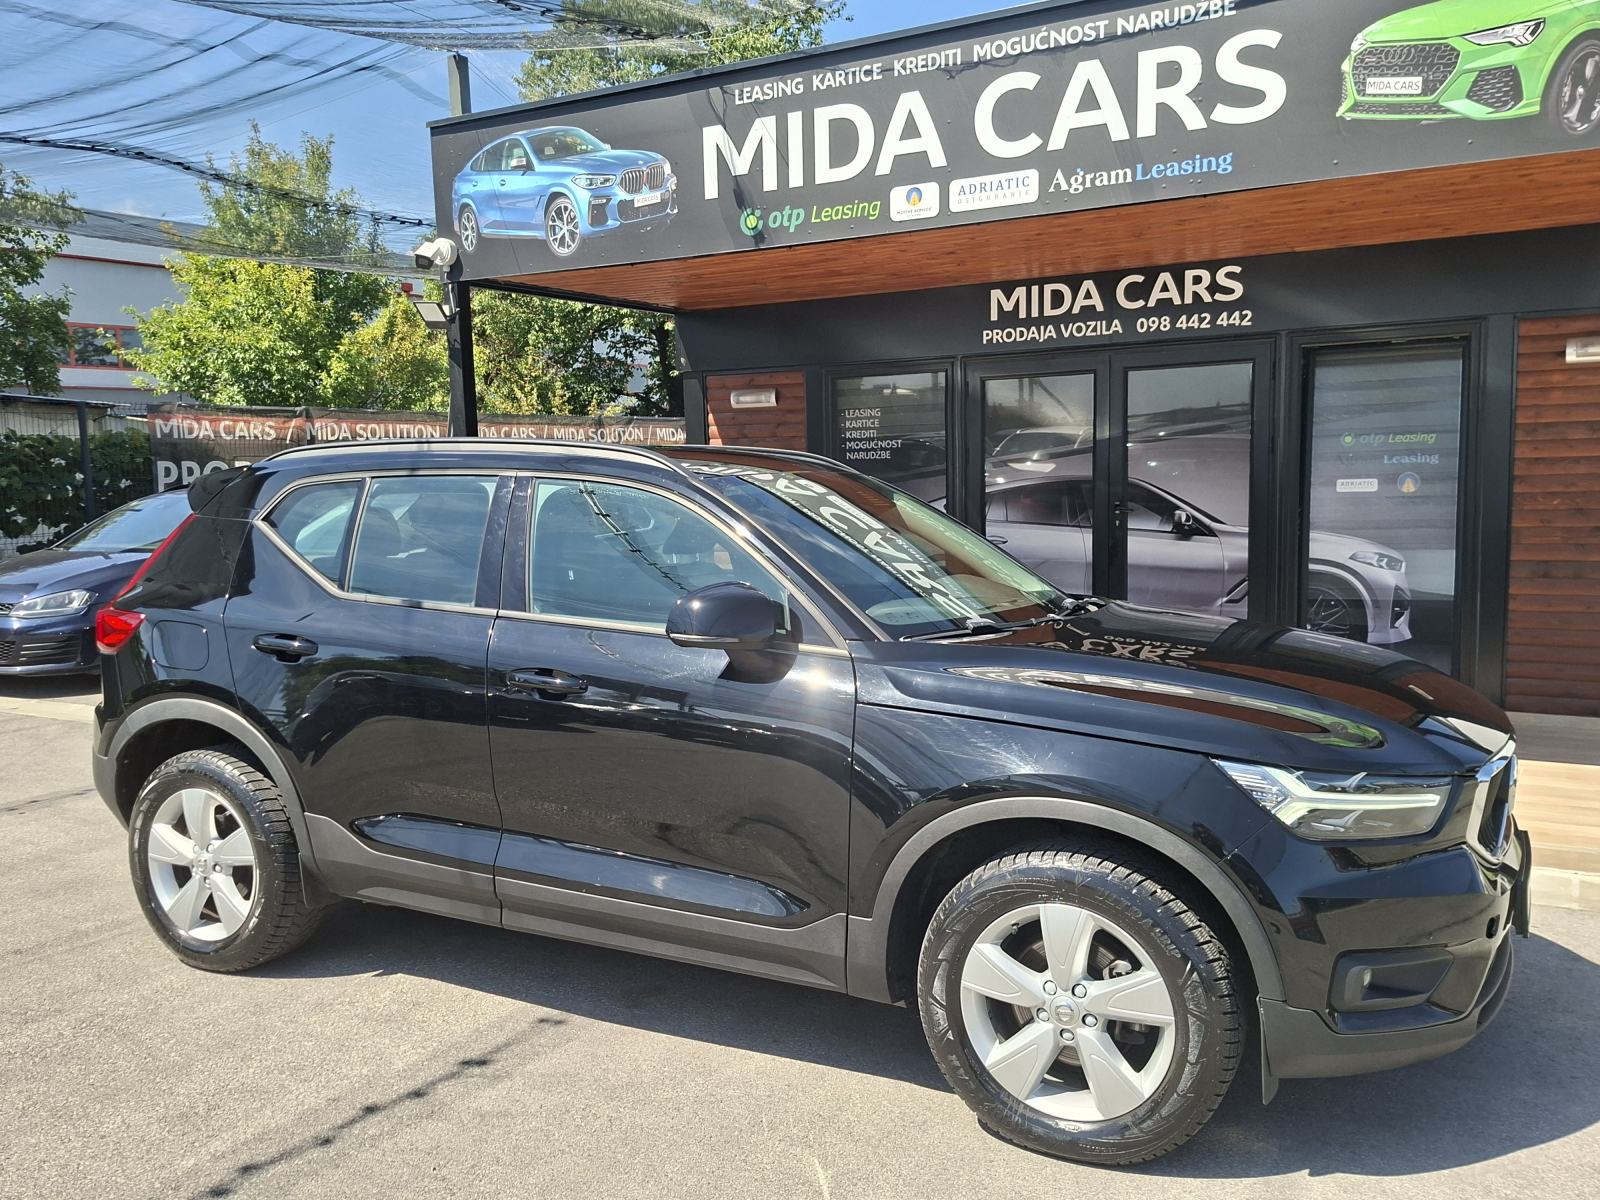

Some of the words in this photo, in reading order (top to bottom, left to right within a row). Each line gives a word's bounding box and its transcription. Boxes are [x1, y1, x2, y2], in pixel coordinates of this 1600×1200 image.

[734, 77, 804, 105] LEASING
[812, 62, 882, 92] KARTICE
[893, 48, 962, 77] KREDITI
[973, 20, 1109, 62] MOGUĆNOST
[1367, 81, 1392, 91] MIDA
[1394, 80, 1420, 91] CARS
[701, 90, 948, 200] MIDA
[973, 28, 1287, 159] CARS
[958, 175, 1030, 196] ADRIATIC
[768, 205, 805, 233] otp
[811, 200, 881, 224] Leasing
[990, 279, 1105, 321] MIDA
[1115, 265, 1245, 310] CARS
[982, 324, 1057, 345] PRODAJA
[1060, 318, 1123, 339] VOZILA
[1136, 314, 1171, 333] 098
[1175, 312, 1211, 331] 442
[1216, 309, 1252, 328] 442
[845, 408, 881, 417] LEASING
[154, 418, 215, 440] MIDA
[219, 421, 277, 441] CARS
[306, 421, 353, 441] MIDA
[356, 423, 440, 441] SOLUTION
[845, 419, 880, 428] KARTICE
[553, 427, 586, 442] MIDA
[589, 427, 644, 444] SOLUTION
[656, 427, 684, 441] MIDA
[845, 430, 877, 439] KREDITI
[1388, 432, 1438, 445] Leasing
[846, 438, 903, 450] MOGUĆNOST
[846, 449, 892, 460] NARUDŽBE
[1383, 453, 1440, 465] Leasing
